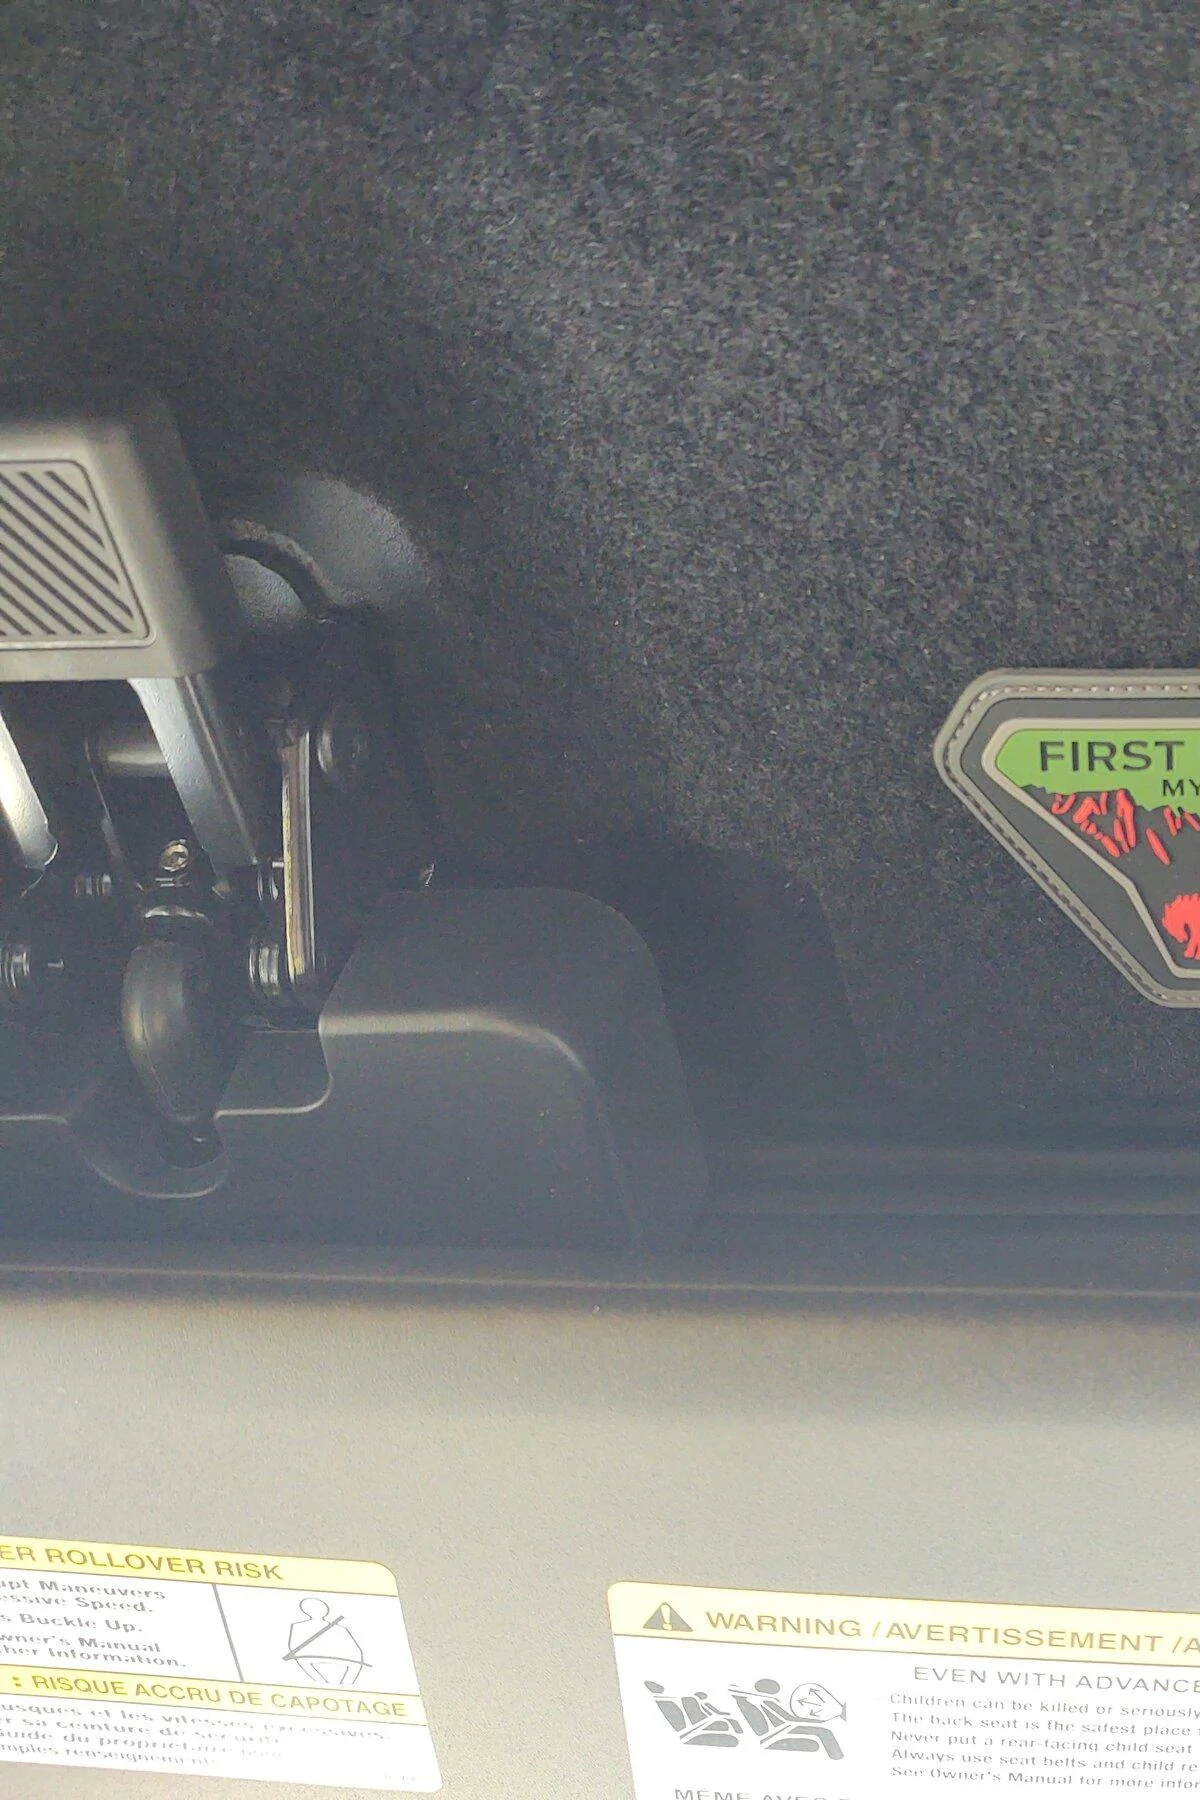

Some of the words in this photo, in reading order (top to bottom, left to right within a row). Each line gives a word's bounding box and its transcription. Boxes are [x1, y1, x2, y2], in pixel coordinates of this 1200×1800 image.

[1039, 740, 1185, 772] FIRST
[45, 1547, 206, 1574] ROLLOVER
[215, 1560, 284, 1580] RISK
[39, 1580, 167, 1599] Maneuvers
[75, 1597, 153, 1612] Speed.
[19, 1613, 97, 1629] Buckle
[105, 1619, 143, 1633] Up.
[705, 1611, 862, 1637] WARNING
[78, 1637, 161, 1653] Manual
[48, 1647, 187, 1667] Information.
[914, 1666, 986, 1684] EVEN
[998, 1670, 1066, 1688] WITH
[32, 1675, 128, 1696] RISQUE
[135, 1683, 220, 1703] ACCRU
[228, 1690, 262, 1706] DE
[270, 1693, 408, 1717] CAPOTAGE
[890, 1692, 965, 1708] Children
[973, 1700, 1004, 1710] can
[1012, 1700, 1033, 1711] be
[1040, 1701, 1089, 1714] killed
[1096, 1705, 1113, 1716] or
[892, 1712, 923, 1724] The
[930, 1714, 973, 1727] back
[980, 1718, 1018, 1729] seat
[1026, 1719, 1040, 1730] is
[1047, 1719, 1075, 1732] the
[1081, 1722, 1136, 1734] safest
[1143, 1724, 1191, 1737] place
[891, 1730, 940, 1743] Never
[948, 1734, 976, 1746] put
[984, 1737, 993, 1746] a
[1001, 1737, 1099, 1753] rear-facing
[1105, 1741, 1149, 1753] child
[1155, 1744, 1192, 1754] seat
[892, 1749, 954, 1763] Always
[962, 1754, 992, 1764] use
[1000, 1755, 1036, 1766] seat
[1043, 1756, 1087, 1768] belts
[1093, 1758, 1125, 1770] and
[1132, 1760, 1175, 1771] child
[892, 1766, 923, 1777] See
[930, 1767, 1001, 1781] Owner's
[1008, 1772, 1072, 1785] Manual
[1080, 1775, 1102, 1786] for
[1110, 1777, 1154, 1788] more
